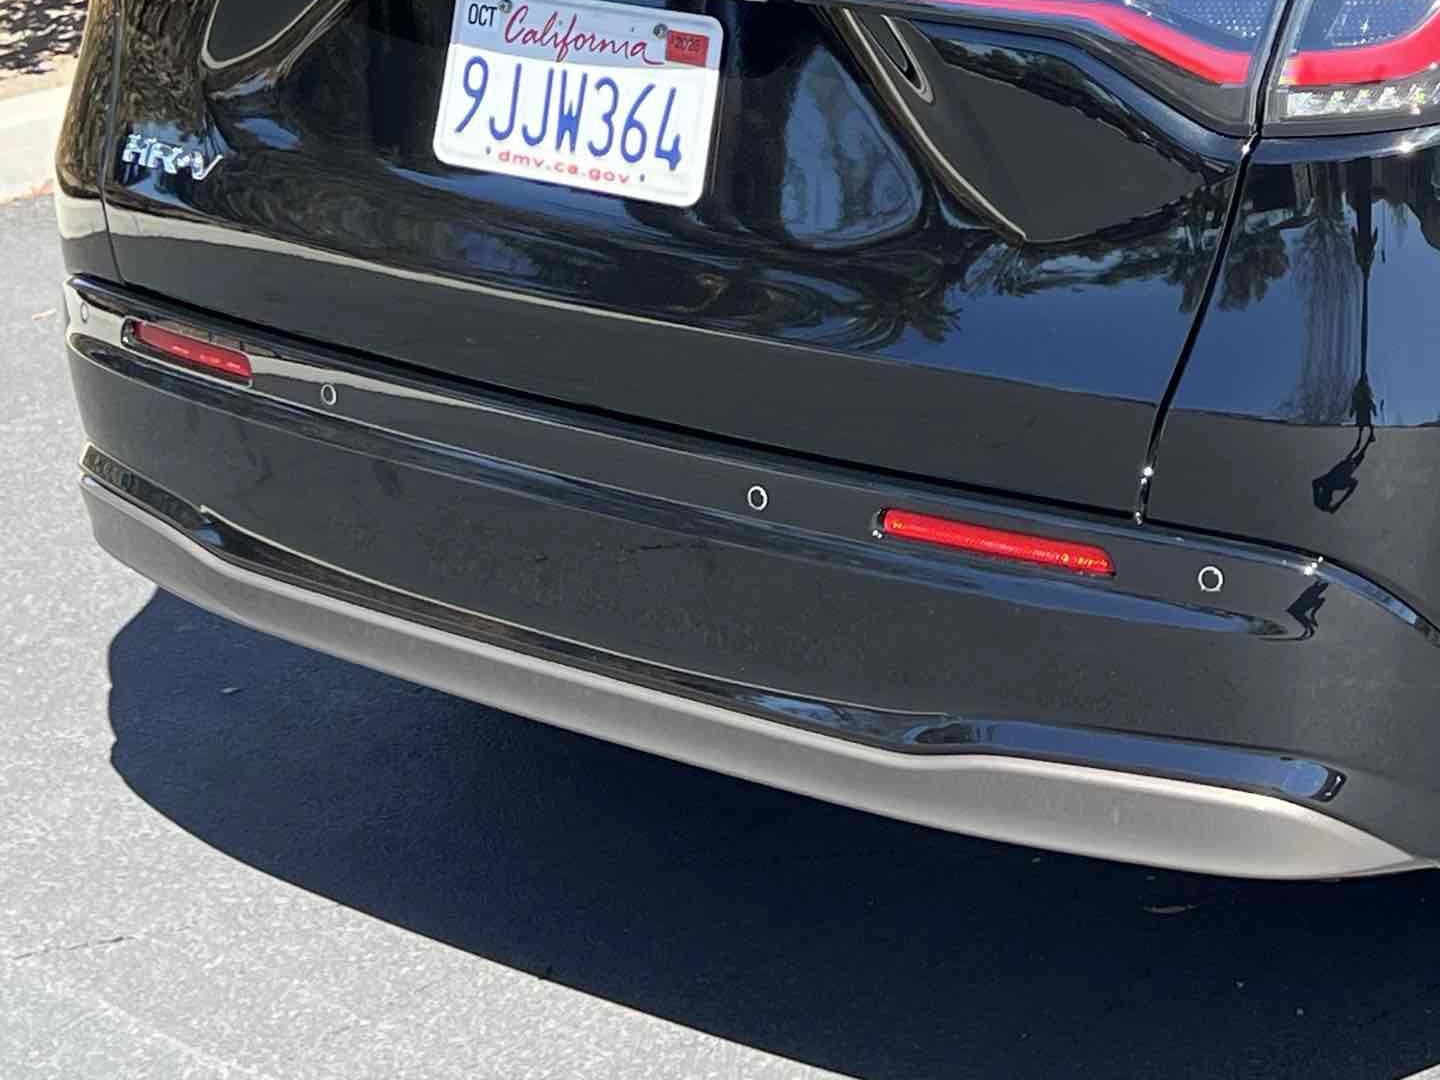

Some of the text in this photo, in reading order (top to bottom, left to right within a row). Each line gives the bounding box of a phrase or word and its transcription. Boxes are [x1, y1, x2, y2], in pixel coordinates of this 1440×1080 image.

[468, 3, 497, 27] OCT
[503, 5, 664, 65] California
[454, 56, 682, 171] 9JJW364
[498, 149, 632, 184] dmv.ca.gov
